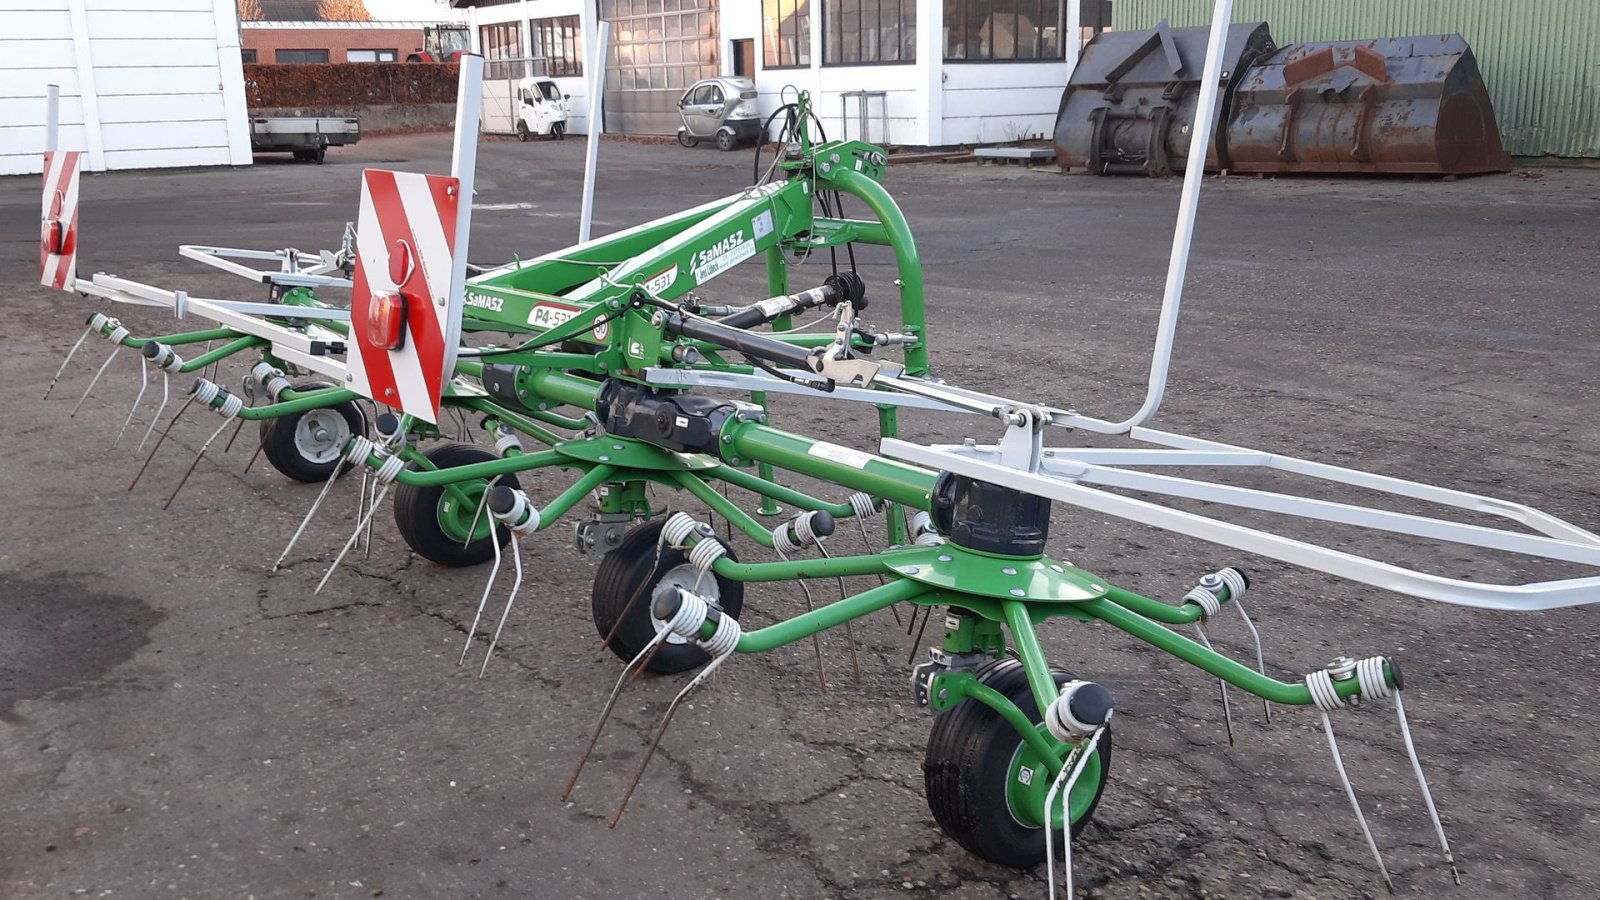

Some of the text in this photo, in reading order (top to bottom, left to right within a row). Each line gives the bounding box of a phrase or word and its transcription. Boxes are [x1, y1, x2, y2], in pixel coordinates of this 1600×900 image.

[699, 229, 744, 266] SaMASZ
[646, 273, 671, 292] -531
[468, 291, 504, 313] SaMASZ
